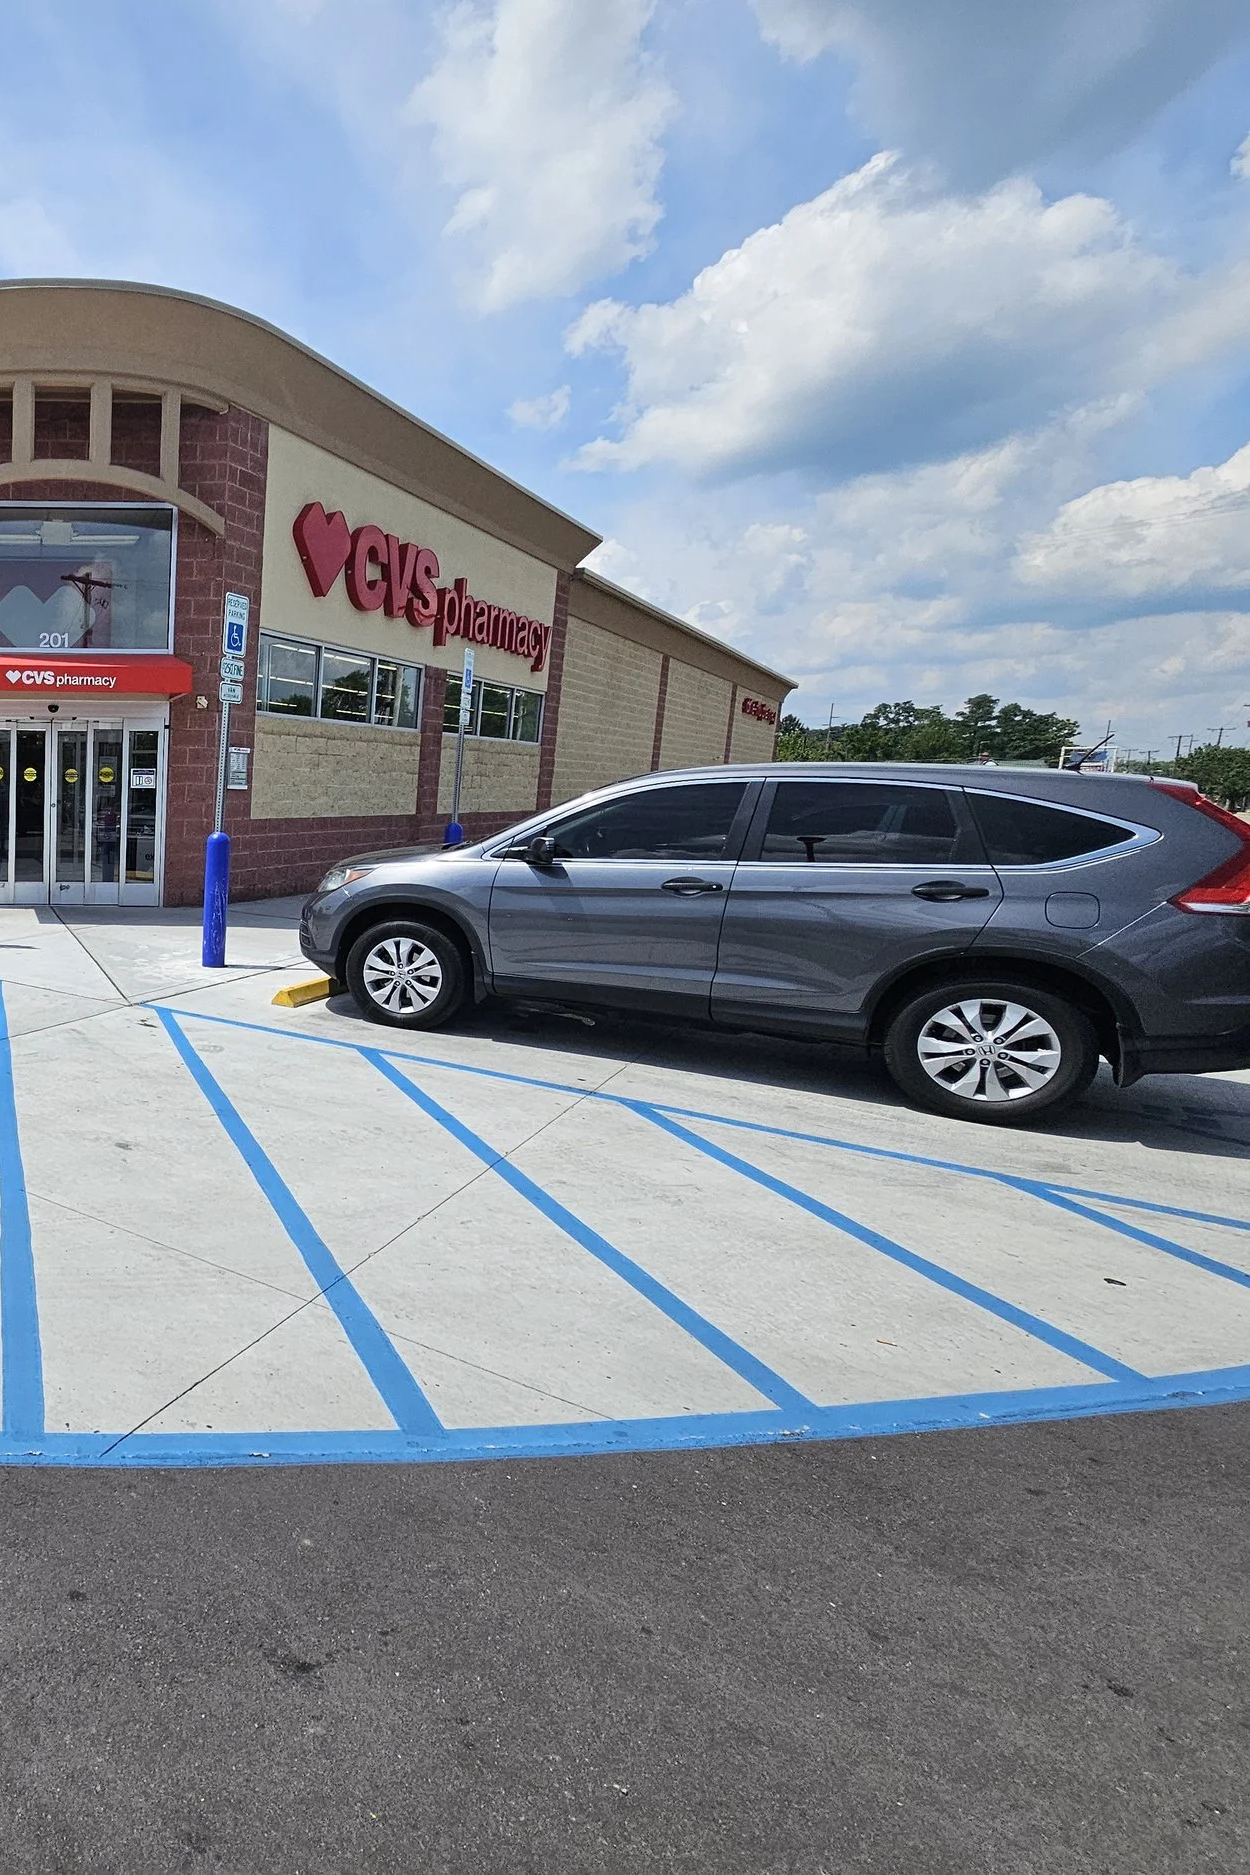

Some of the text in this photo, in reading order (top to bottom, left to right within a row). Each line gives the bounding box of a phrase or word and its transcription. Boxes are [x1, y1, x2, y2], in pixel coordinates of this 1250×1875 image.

[345, 524, 552, 672] CVS pharmacy
[39, 632, 69, 648] 201
[21, 670, 117, 689] CVS pharmacy
